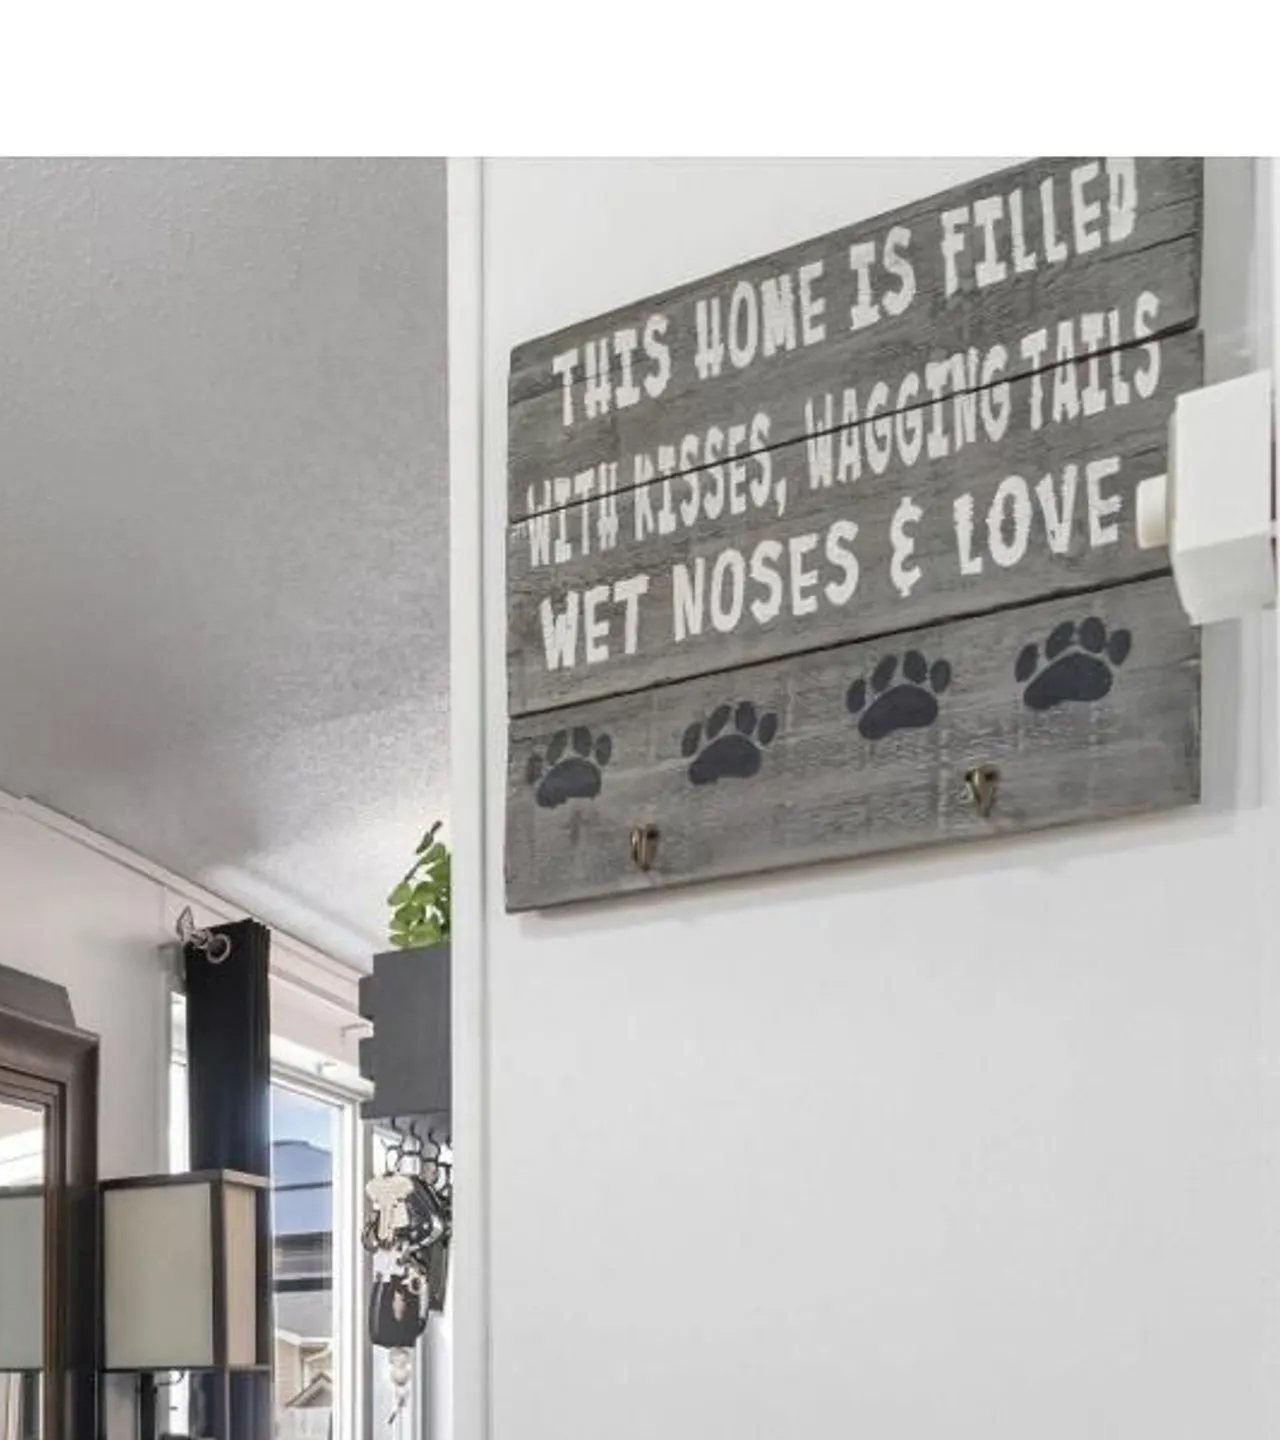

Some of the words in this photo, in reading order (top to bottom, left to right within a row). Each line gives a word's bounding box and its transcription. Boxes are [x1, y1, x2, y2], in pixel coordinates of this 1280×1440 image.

[552, 313, 671, 427] THIS
[694, 262, 826, 380] HOME
[849, 225, 916, 332] IS
[941, 156, 1138, 298] FILLED
[527, 462, 618, 567] WITH
[805, 343, 1012, 491] WAGGING
[1020, 291, 1160, 431] TAILS
[540, 575, 649, 671] WET
[672, 519, 860, 642] NOSES
[889, 497, 923, 598] &
[953, 456, 1123, 577] LOVE
